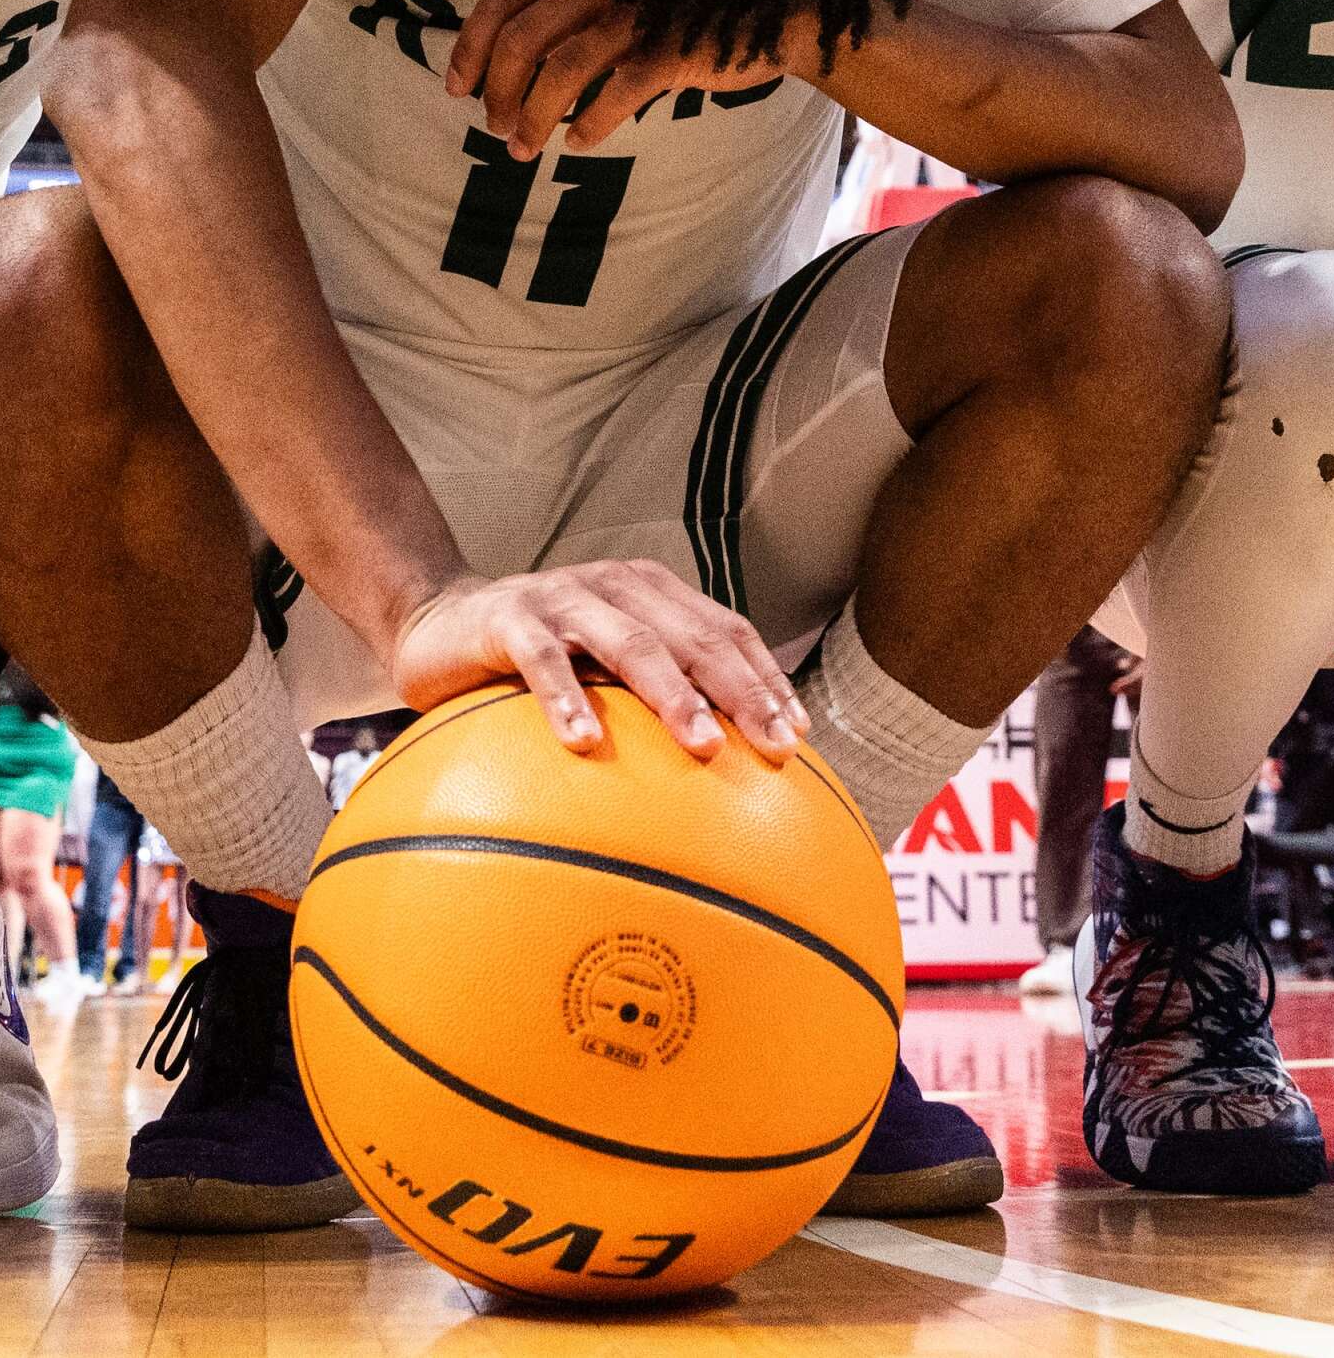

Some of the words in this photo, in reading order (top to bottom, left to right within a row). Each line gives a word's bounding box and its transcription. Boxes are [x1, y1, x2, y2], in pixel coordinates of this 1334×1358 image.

[440, 125, 637, 307] 11
[902, 779, 1039, 854] AN
[889, 870, 1037, 926] ENTE
[427, 1179, 697, 1280] EVO
